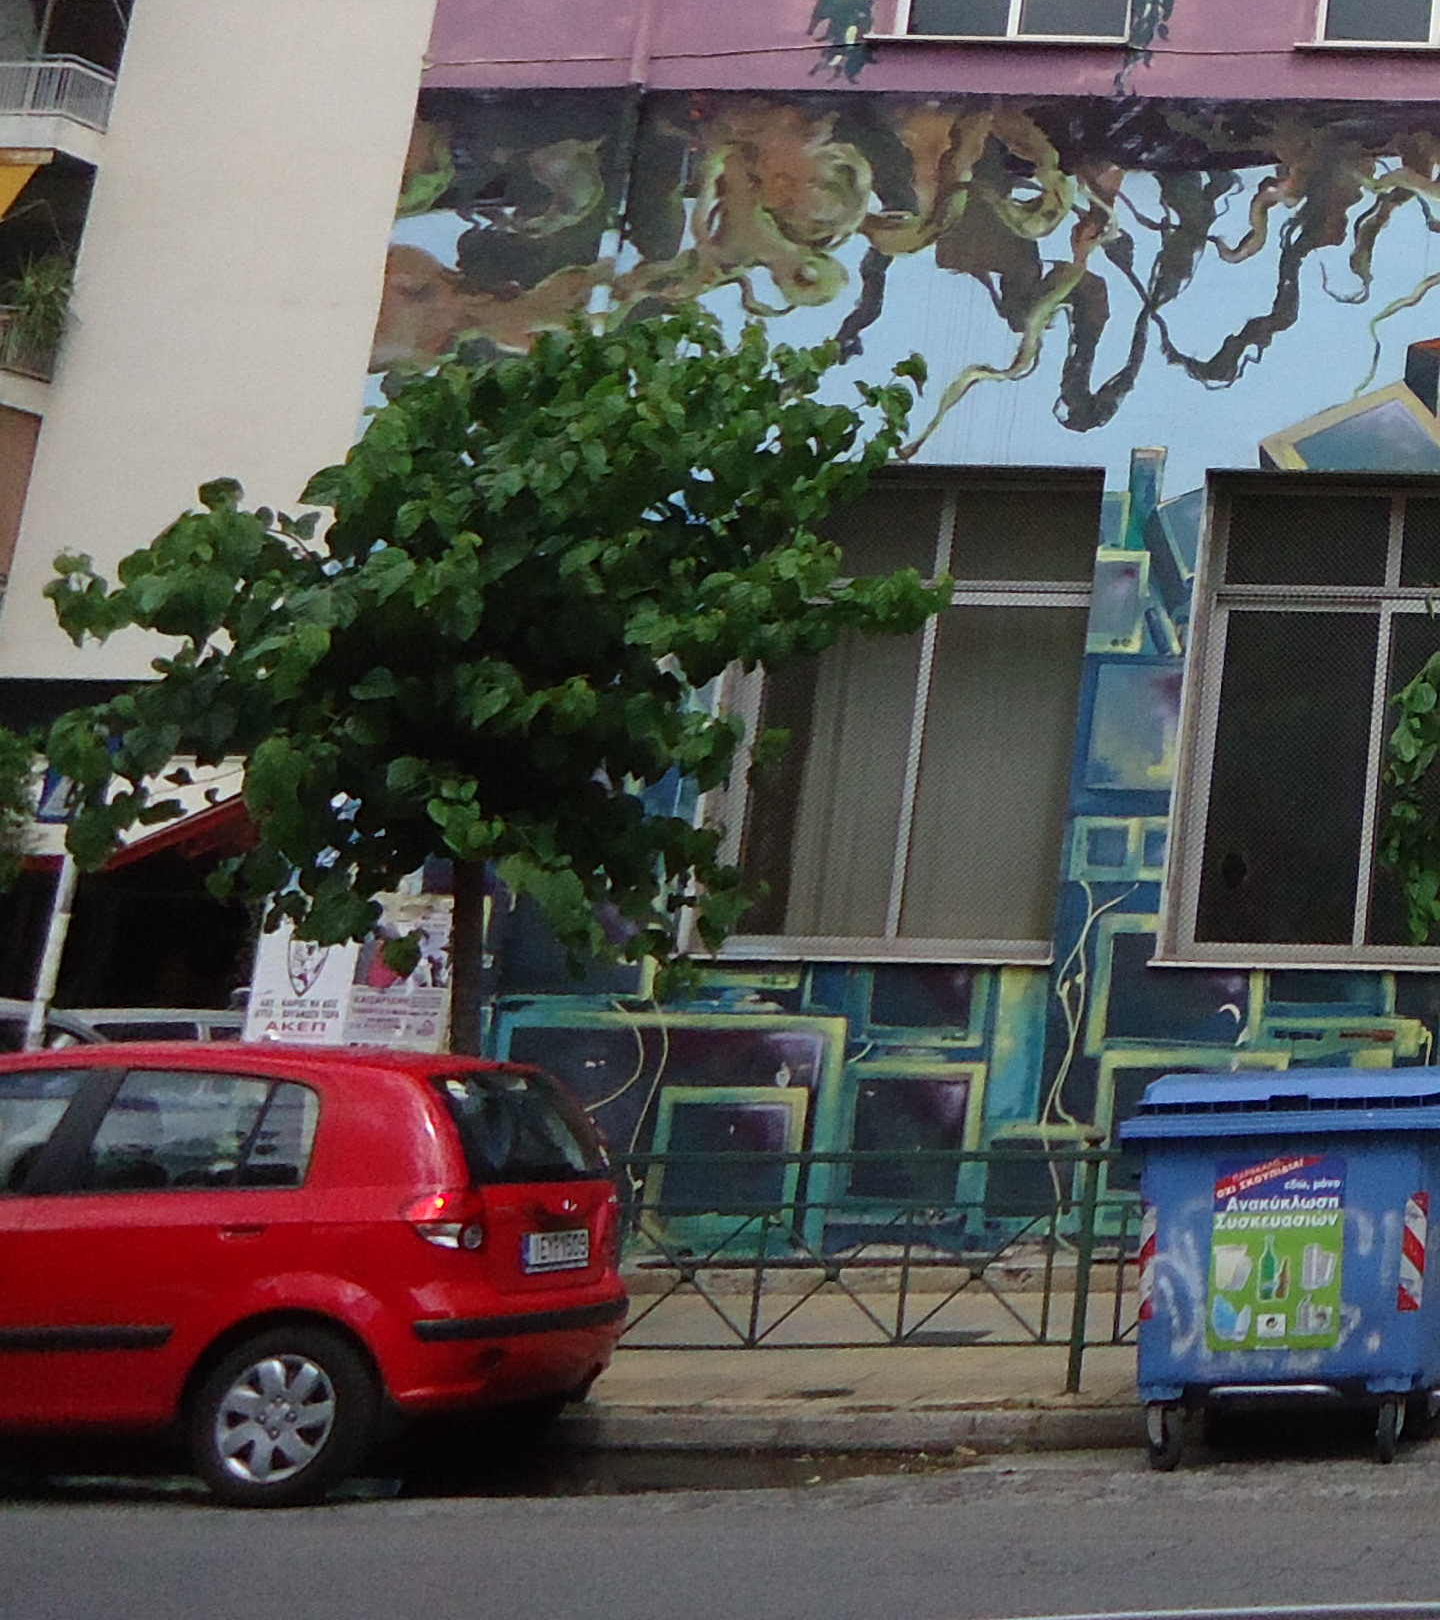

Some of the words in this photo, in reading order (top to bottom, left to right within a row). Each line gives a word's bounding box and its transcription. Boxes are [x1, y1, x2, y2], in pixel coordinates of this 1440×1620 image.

[1239, 1158, 1304, 1190] ΣΚΟΥΠΙΔΙΑ!
[1312, 1177, 1341, 1192] μόνο
[1226, 1194, 1340, 1212] Ανακύκλωση
[1213, 1210, 1339, 1230] Συσκευασιών
